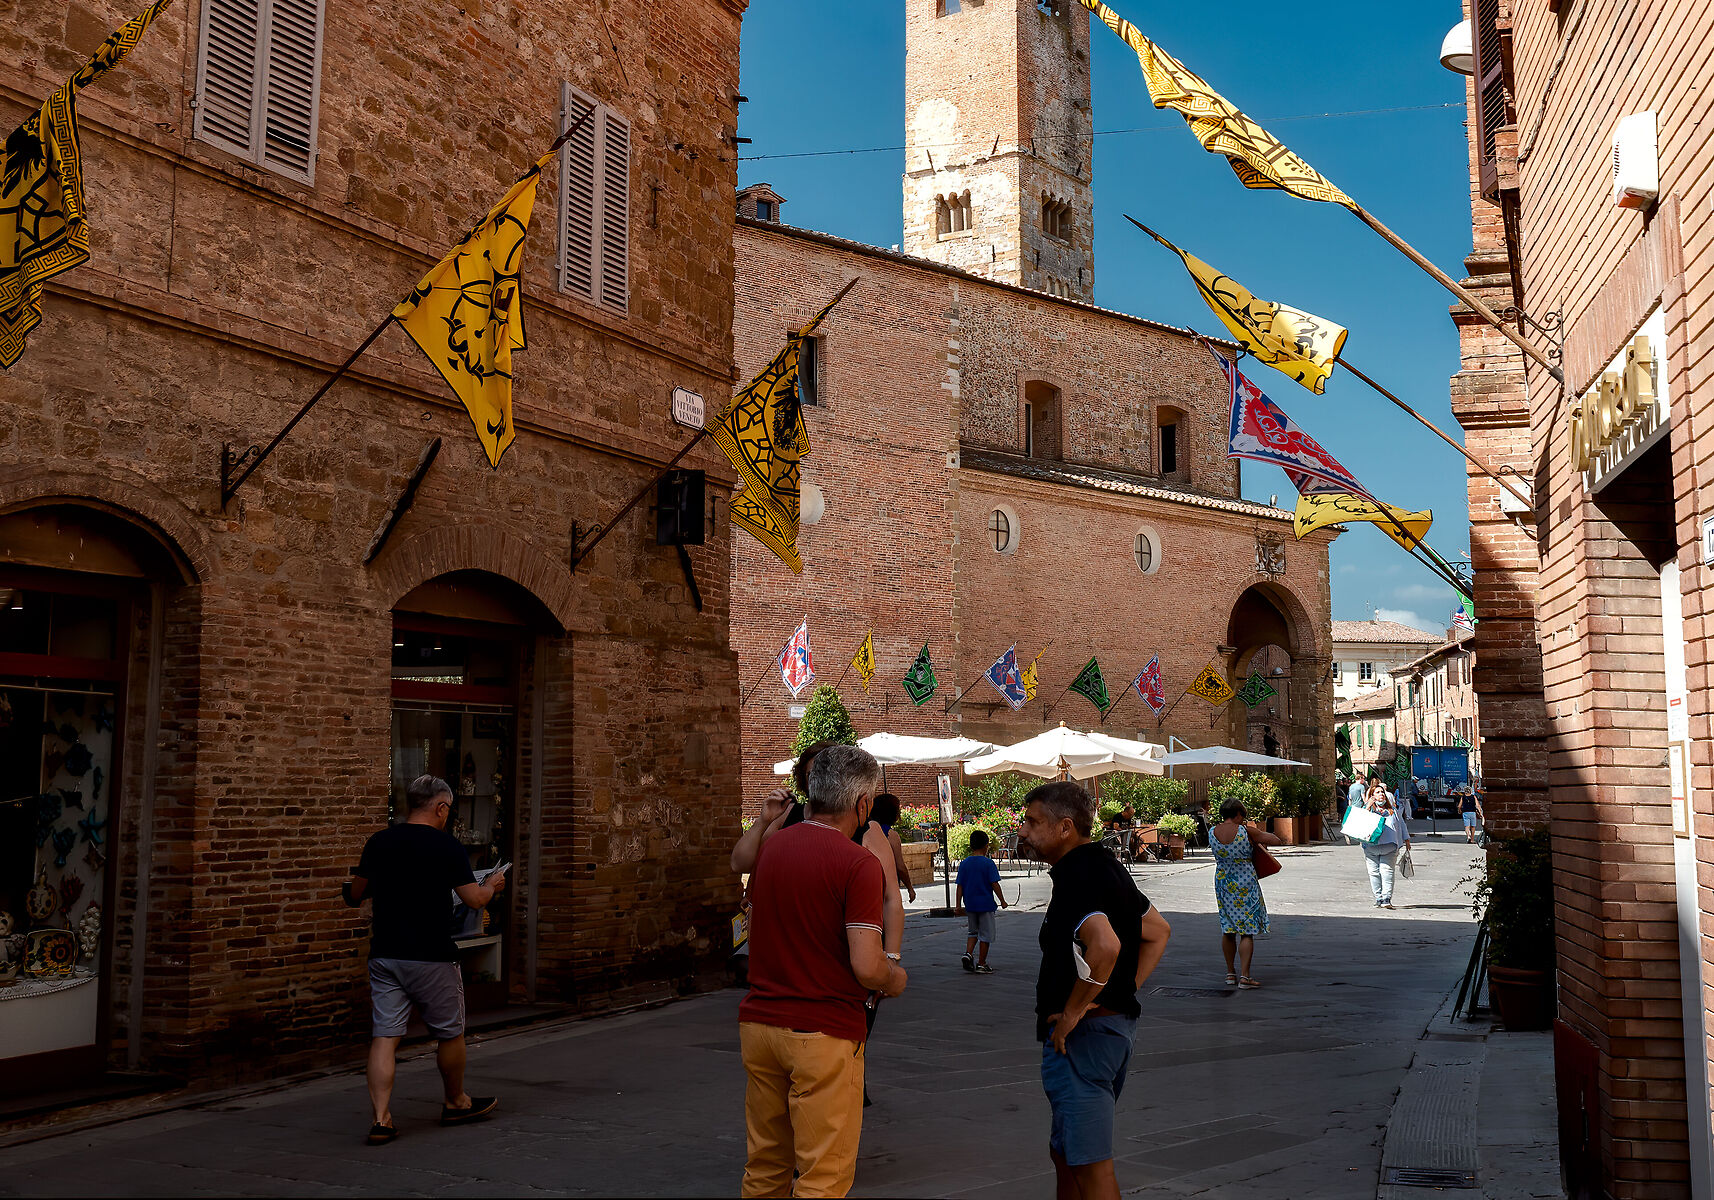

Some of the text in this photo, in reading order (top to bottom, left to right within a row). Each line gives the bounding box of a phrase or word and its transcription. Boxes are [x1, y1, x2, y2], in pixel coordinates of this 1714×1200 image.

[685, 394, 694, 404] VIA
[677, 400, 703, 416] VITTORIO
[679, 410, 701, 424] VENETO
